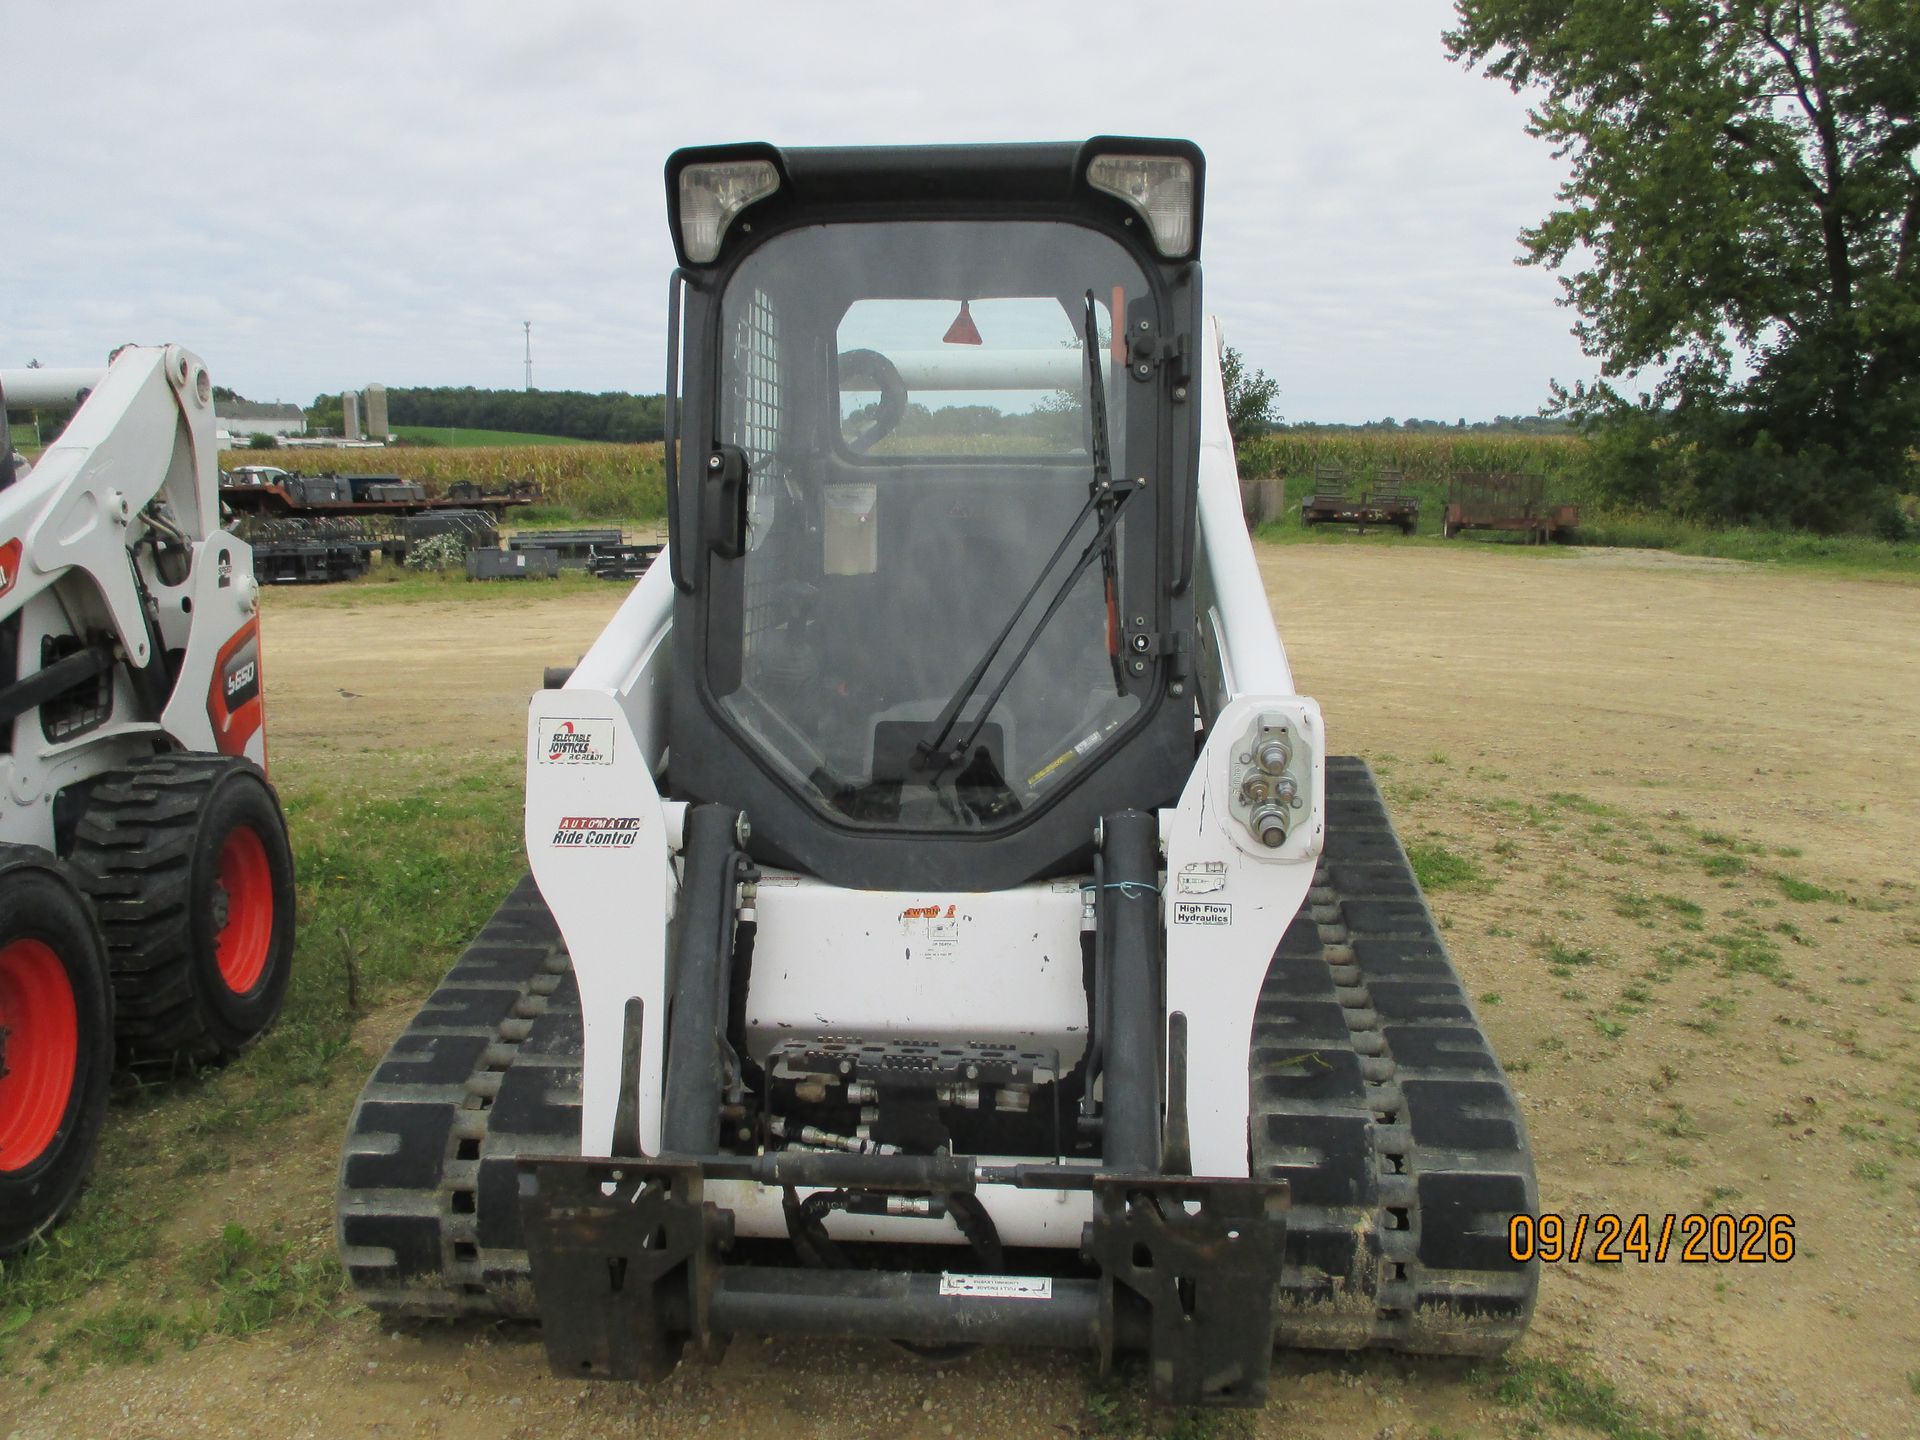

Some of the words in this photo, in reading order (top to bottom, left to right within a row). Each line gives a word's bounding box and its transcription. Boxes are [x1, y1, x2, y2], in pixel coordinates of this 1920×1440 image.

[227, 661, 254, 696] S650
[552, 733, 591, 742] SELECTABLE
[549, 742, 589, 753] JOYSTICKS
[561, 819, 640, 828] AUTOMATIC
[553, 830, 583, 844] Ride
[585, 831, 638, 845] Control
[1179, 905, 1201, 913] High
[1204, 905, 1227, 913] Flow
[1178, 914, 1228, 922] Hydraulics
